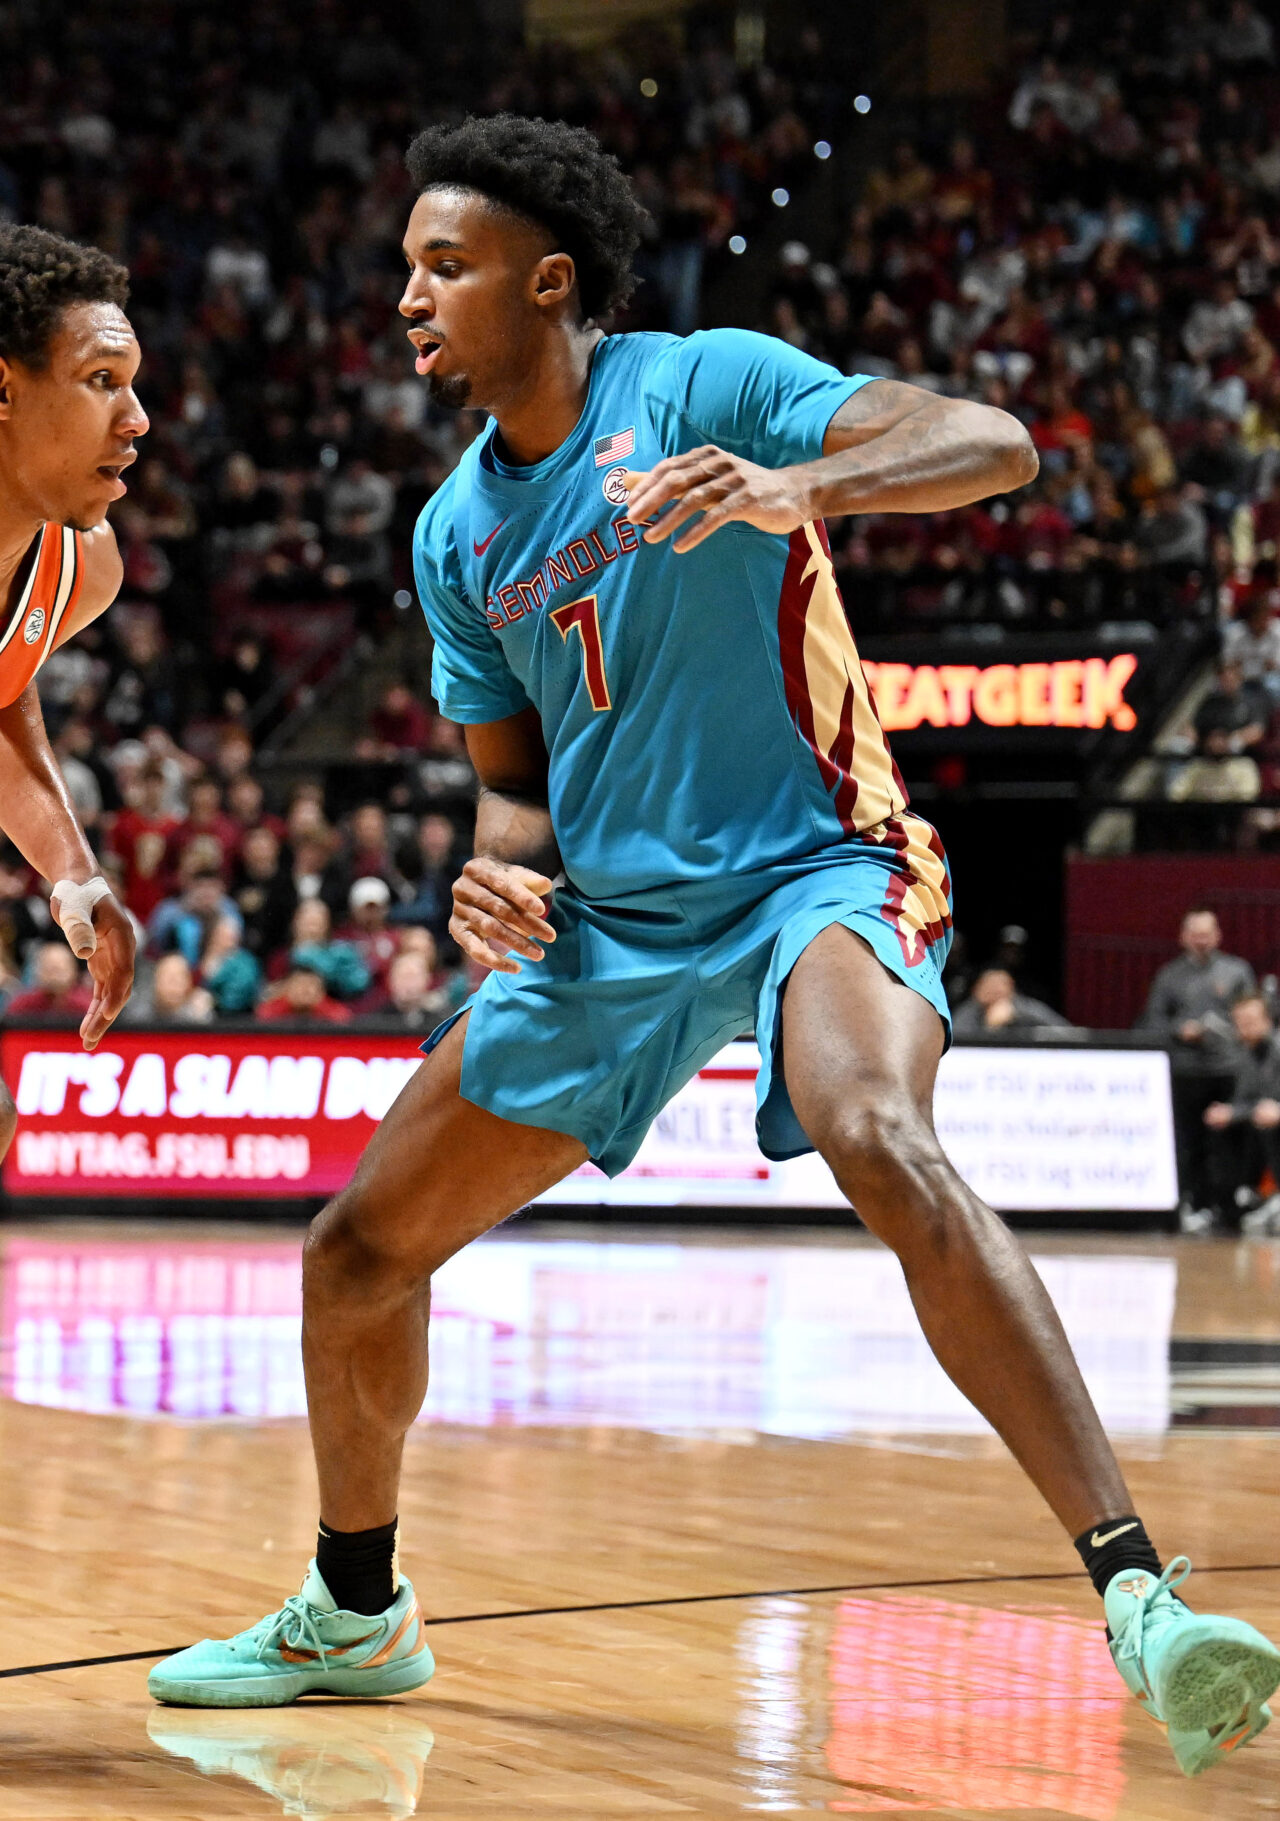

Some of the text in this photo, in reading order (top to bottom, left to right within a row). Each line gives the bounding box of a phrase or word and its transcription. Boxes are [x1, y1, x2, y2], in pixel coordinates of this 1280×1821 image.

[548, 593, 612, 712] 7
[17, 1052, 424, 1121] IT'S A SLAM DU
